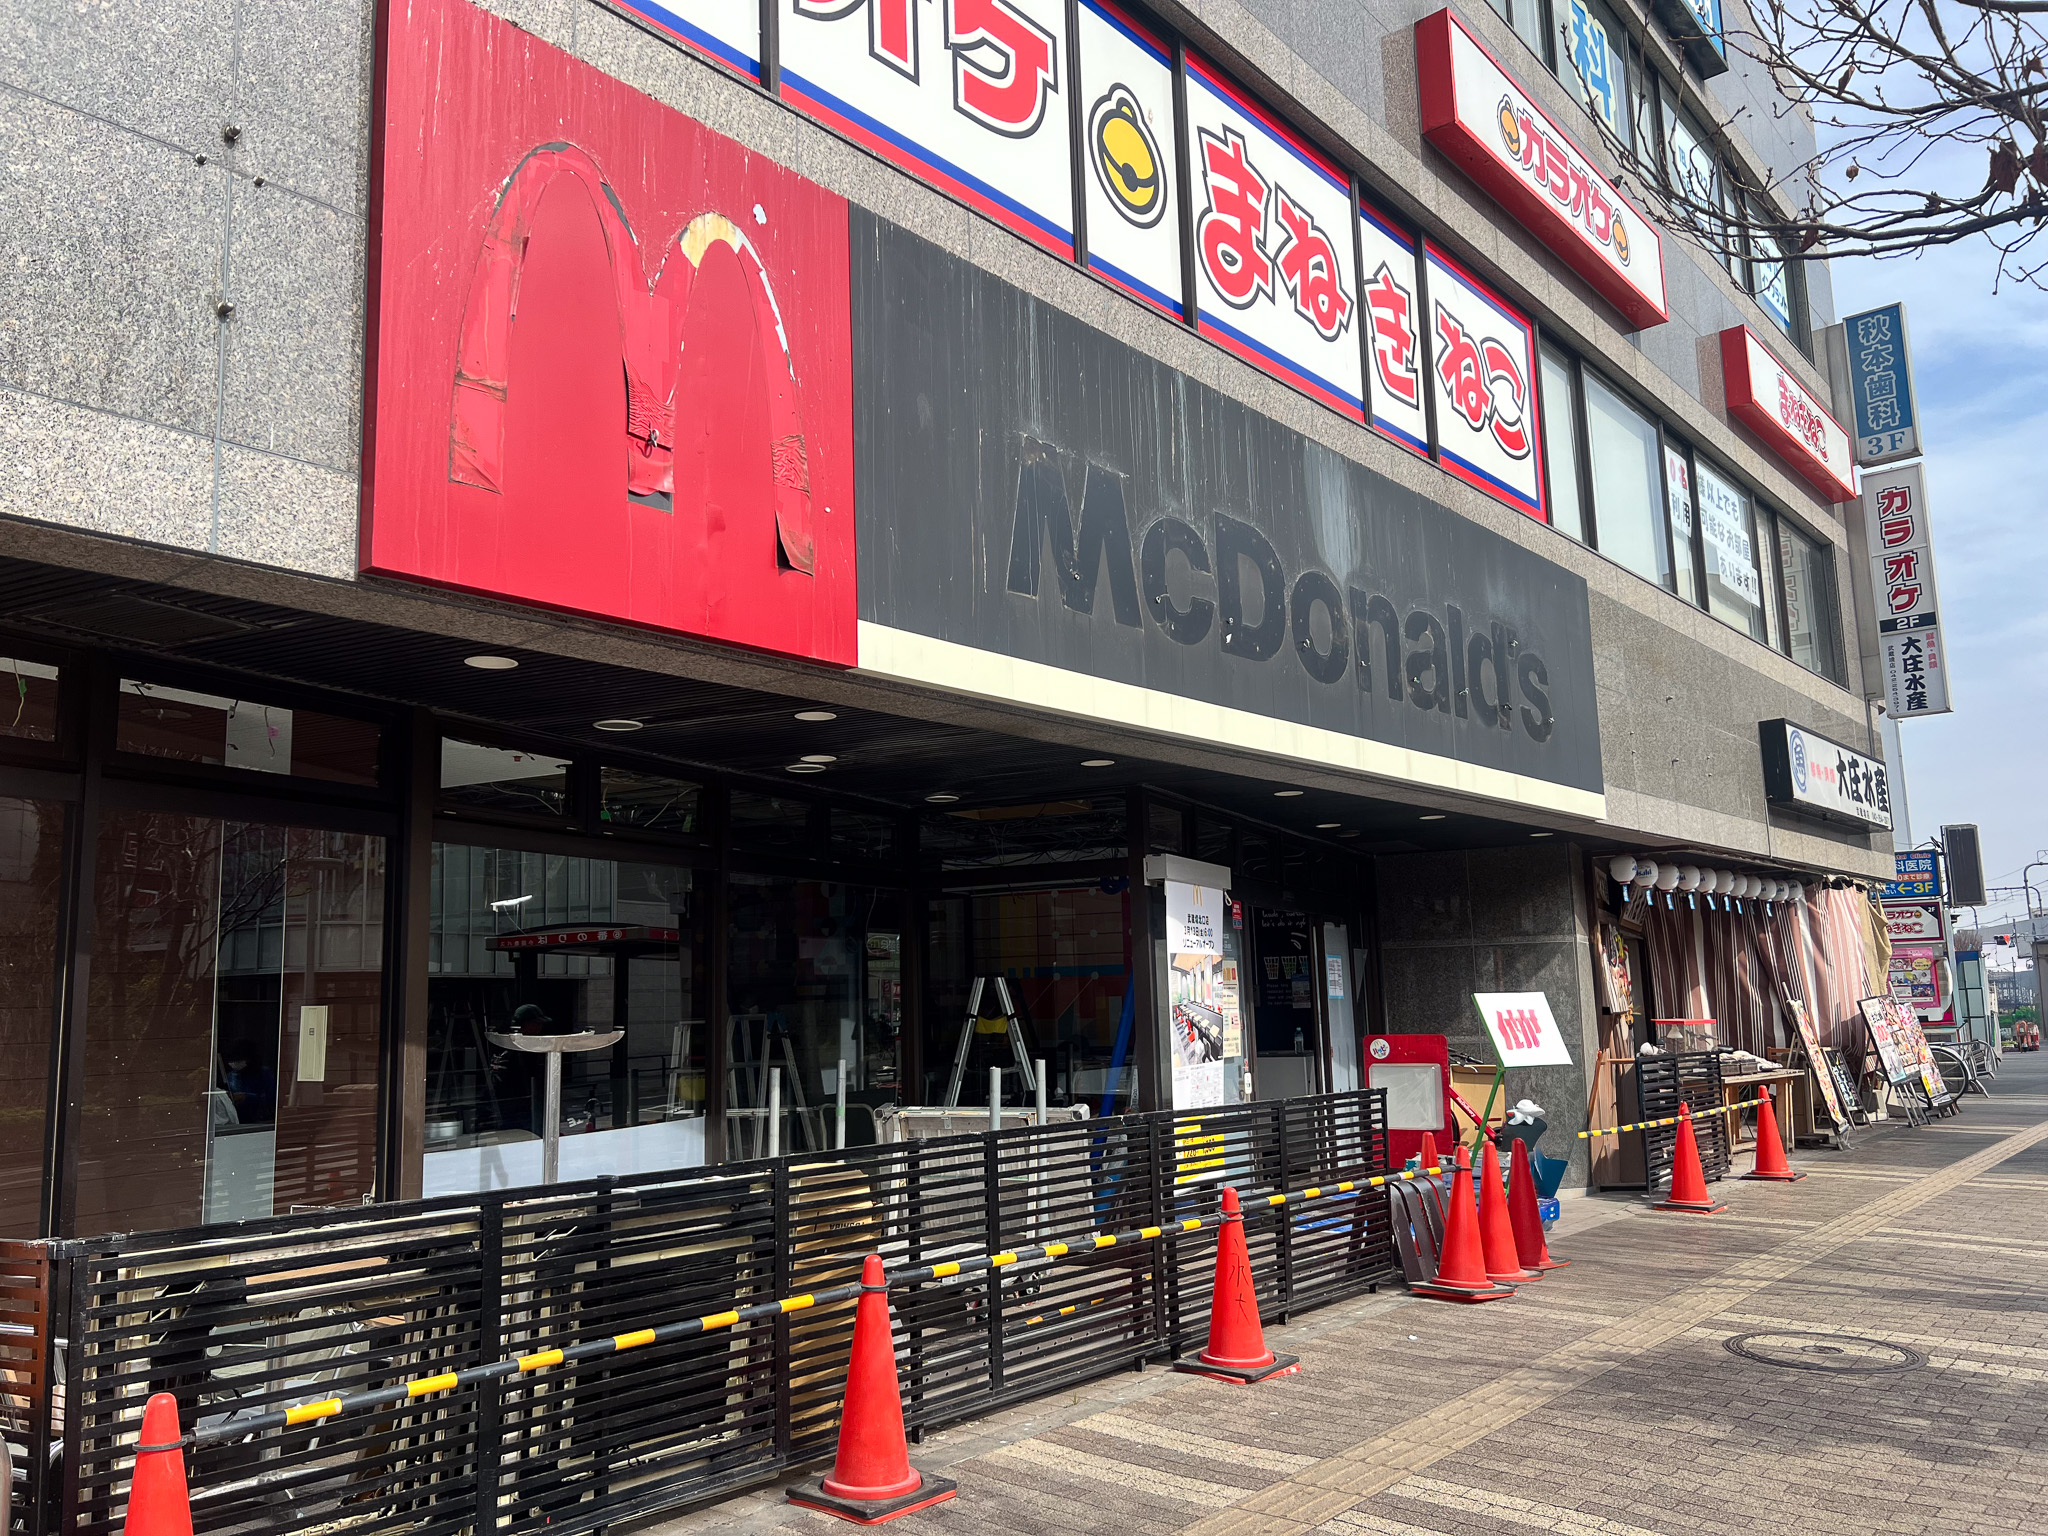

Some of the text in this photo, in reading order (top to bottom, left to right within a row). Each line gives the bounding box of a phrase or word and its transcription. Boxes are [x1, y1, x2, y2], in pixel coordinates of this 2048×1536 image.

[1517, 108, 1612, 246] カラオケ
[1197, 124, 1531, 460] まねきねこ
[1777, 371, 1828, 462] まねきねこ
[1858, 314, 1901, 431] 秋本歯科
[1868, 431, 1906, 457] 3F
[1006, 432, 1555, 744] McDonald's
[1877, 486, 1921, 615] カラオケ
[1896, 615, 1920, 630] 2F
[1901, 636, 1929, 711] 大庄水産
[1836, 750, 1889, 813] 大庄水産
[1913, 882, 1934, 893] 3F
